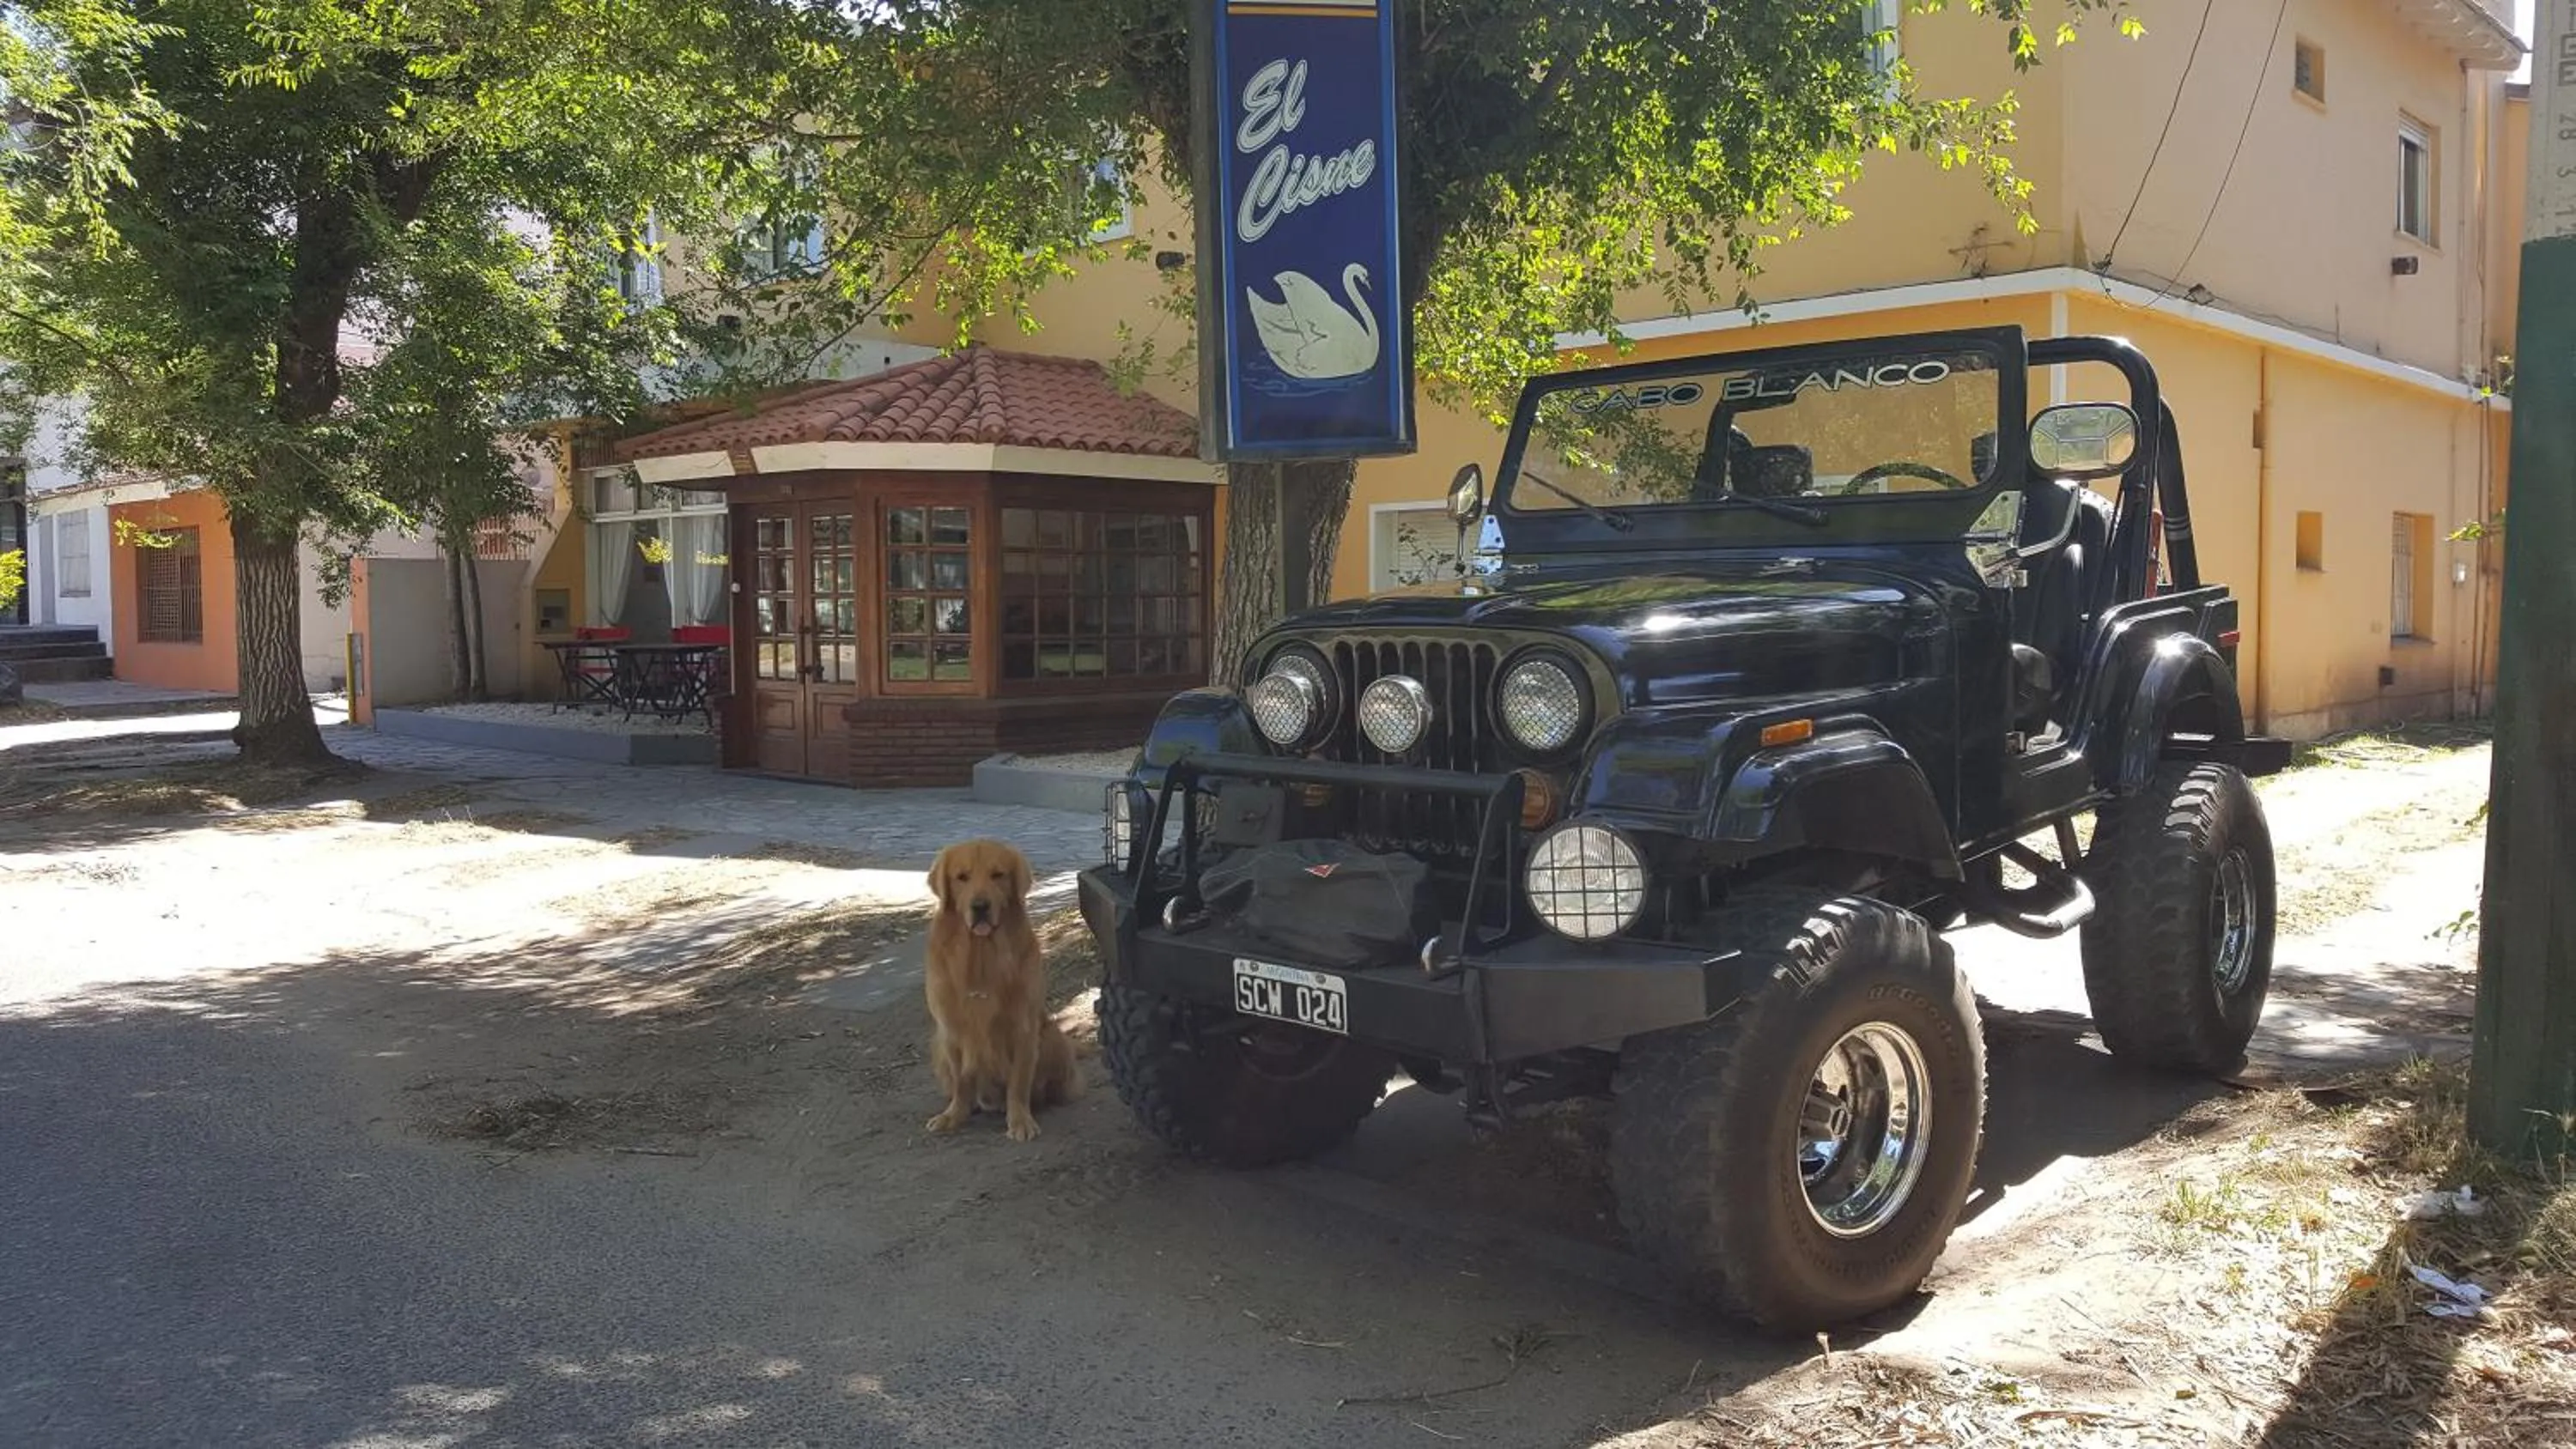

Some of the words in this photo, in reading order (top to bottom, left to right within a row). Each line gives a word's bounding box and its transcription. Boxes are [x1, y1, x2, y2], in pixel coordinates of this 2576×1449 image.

[1236, 58, 1308, 154] El
[1237, 138, 1376, 243] Cisne
[1571, 383, 1704, 415] CABO
[1722, 361, 1951, 403] BLANCO
[1239, 975, 1283, 1016] SCW
[1296, 986, 1342, 1029] 024
